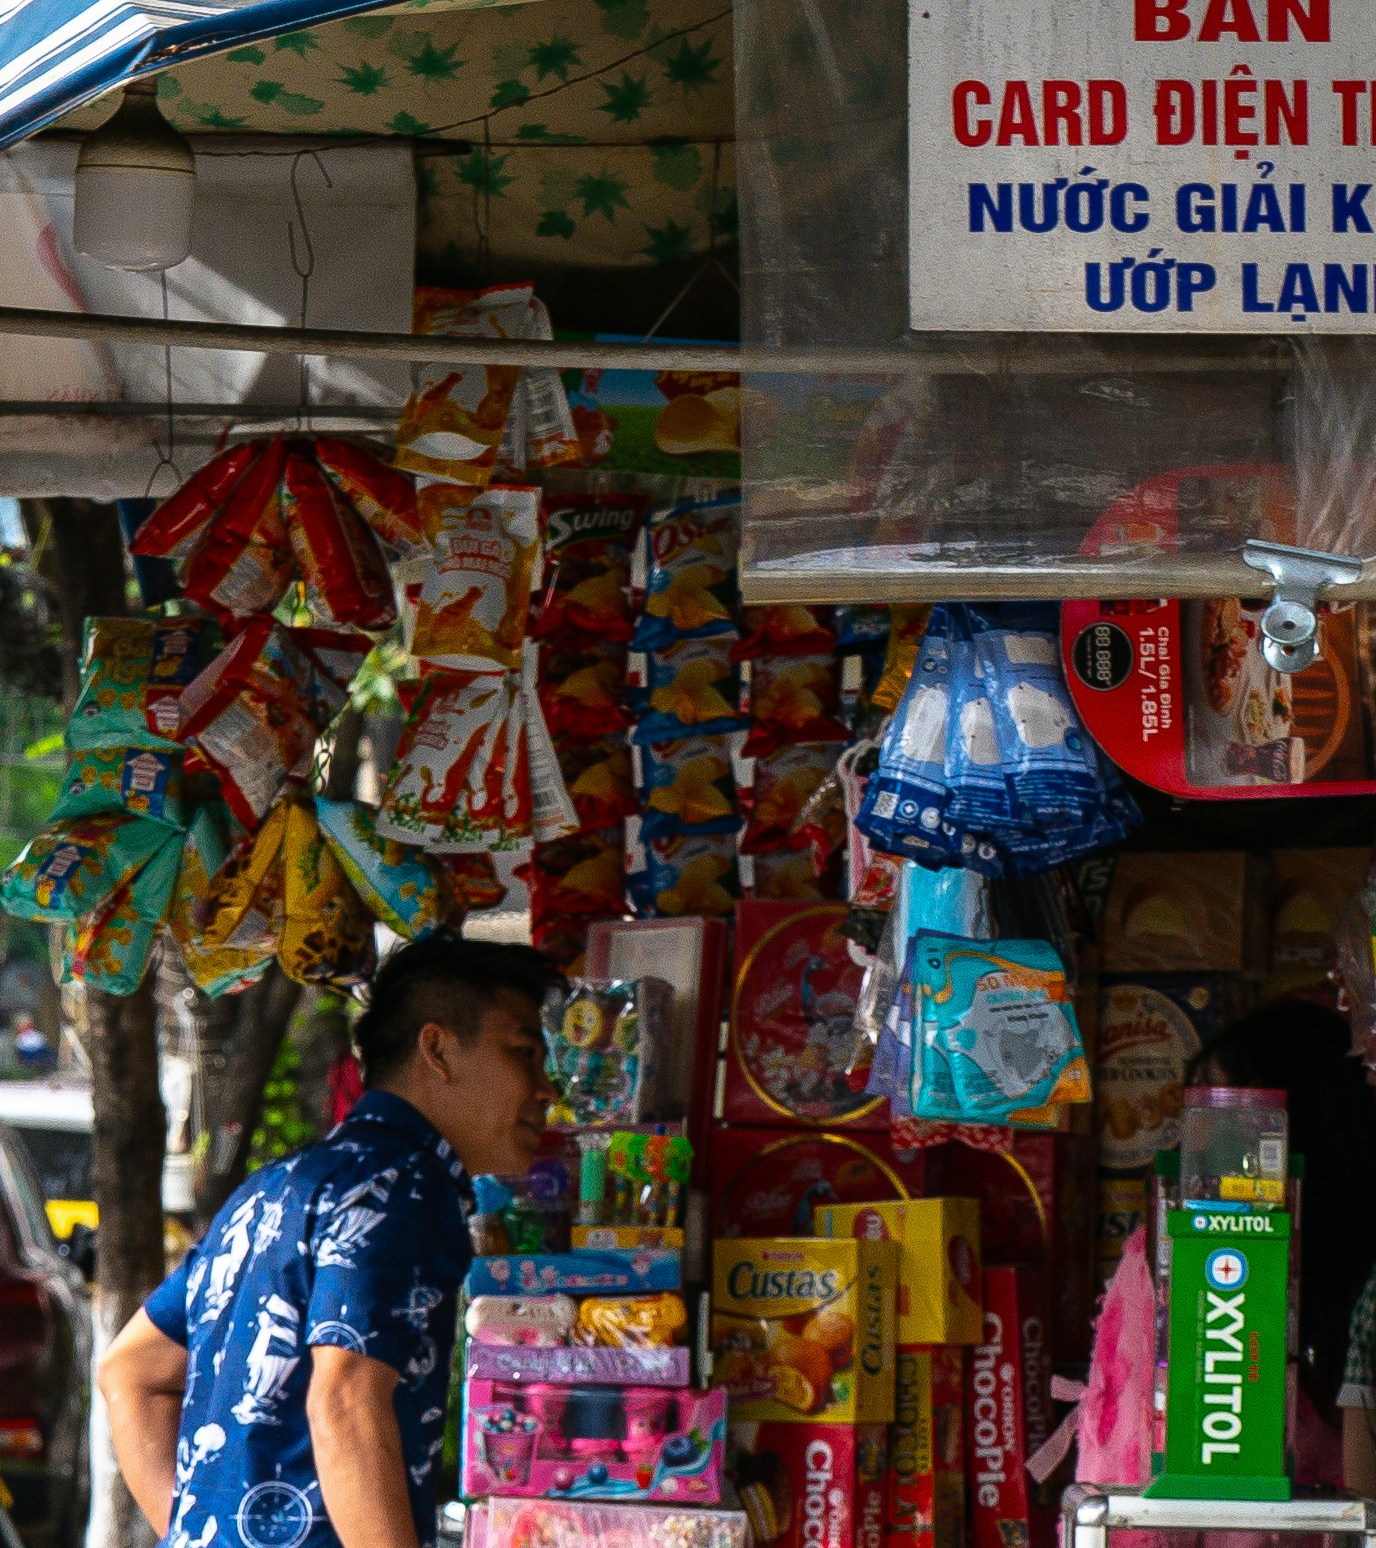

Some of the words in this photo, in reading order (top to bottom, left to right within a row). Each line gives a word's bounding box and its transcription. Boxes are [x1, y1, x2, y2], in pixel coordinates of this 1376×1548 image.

[953, 78, 1130, 148] CARD
[1154, 65, 1312, 163] ĐIỆN
[967, 165, 1151, 236] NƯỚC
[1175, 161, 1308, 236] GIẢI
[1084, 248, 1212, 314] ƯỚP
[549, 504, 635, 547] Swing
[1137, 626, 1157, 680] 1.5L/
[1140, 684, 1158, 743] 1.85L
[1208, 1215, 1274, 1233] XYLITOL
[727, 1259, 836, 1302] Custas
[859, 1266, 883, 1378] Custas
[975, 1312, 1005, 1509] ChocoPie
[1202, 1291, 1247, 1466] XYLITOL
